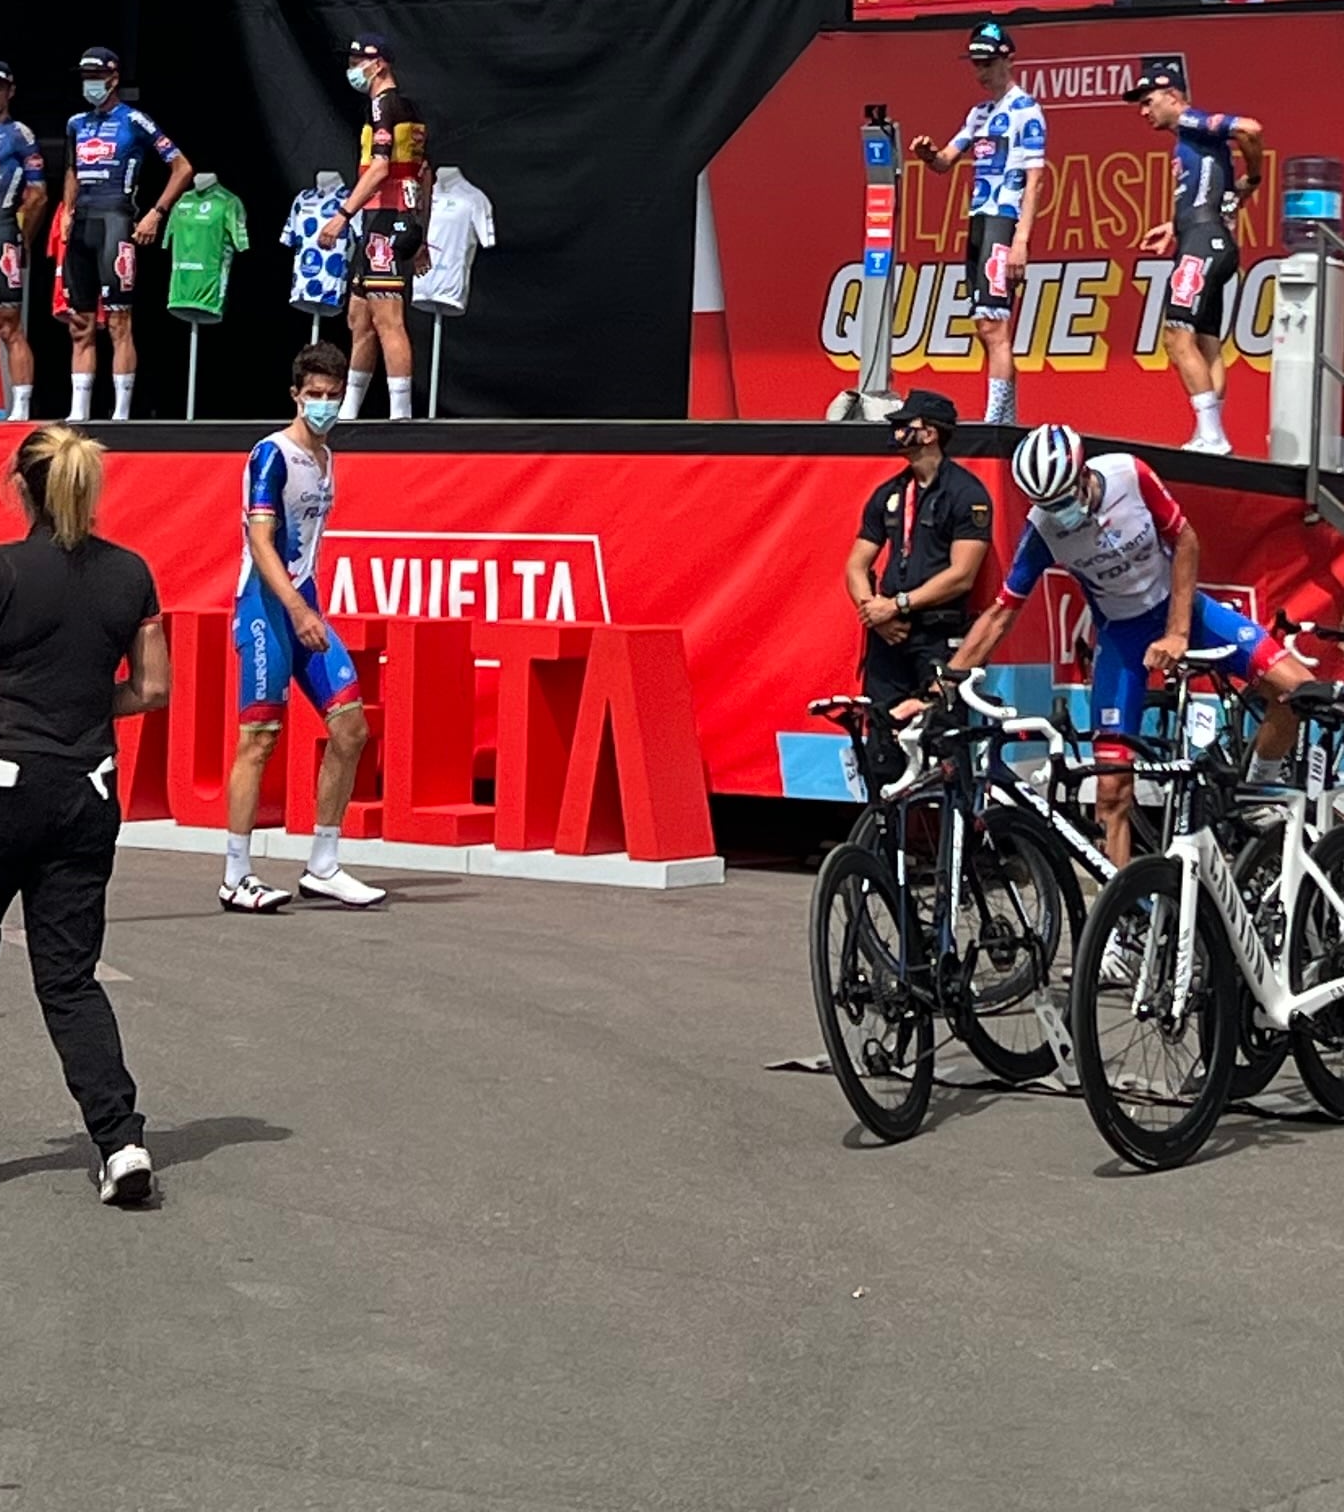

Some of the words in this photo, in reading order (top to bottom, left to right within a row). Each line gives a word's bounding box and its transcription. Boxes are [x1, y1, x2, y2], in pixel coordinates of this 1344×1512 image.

[1051, 64, 1135, 100] VUELTA
[328, 556, 358, 615] A
[370, 557, 577, 622] VUELTA
[250, 618, 268, 701] Groupama
[1209, 843, 1268, 981] CANYON
